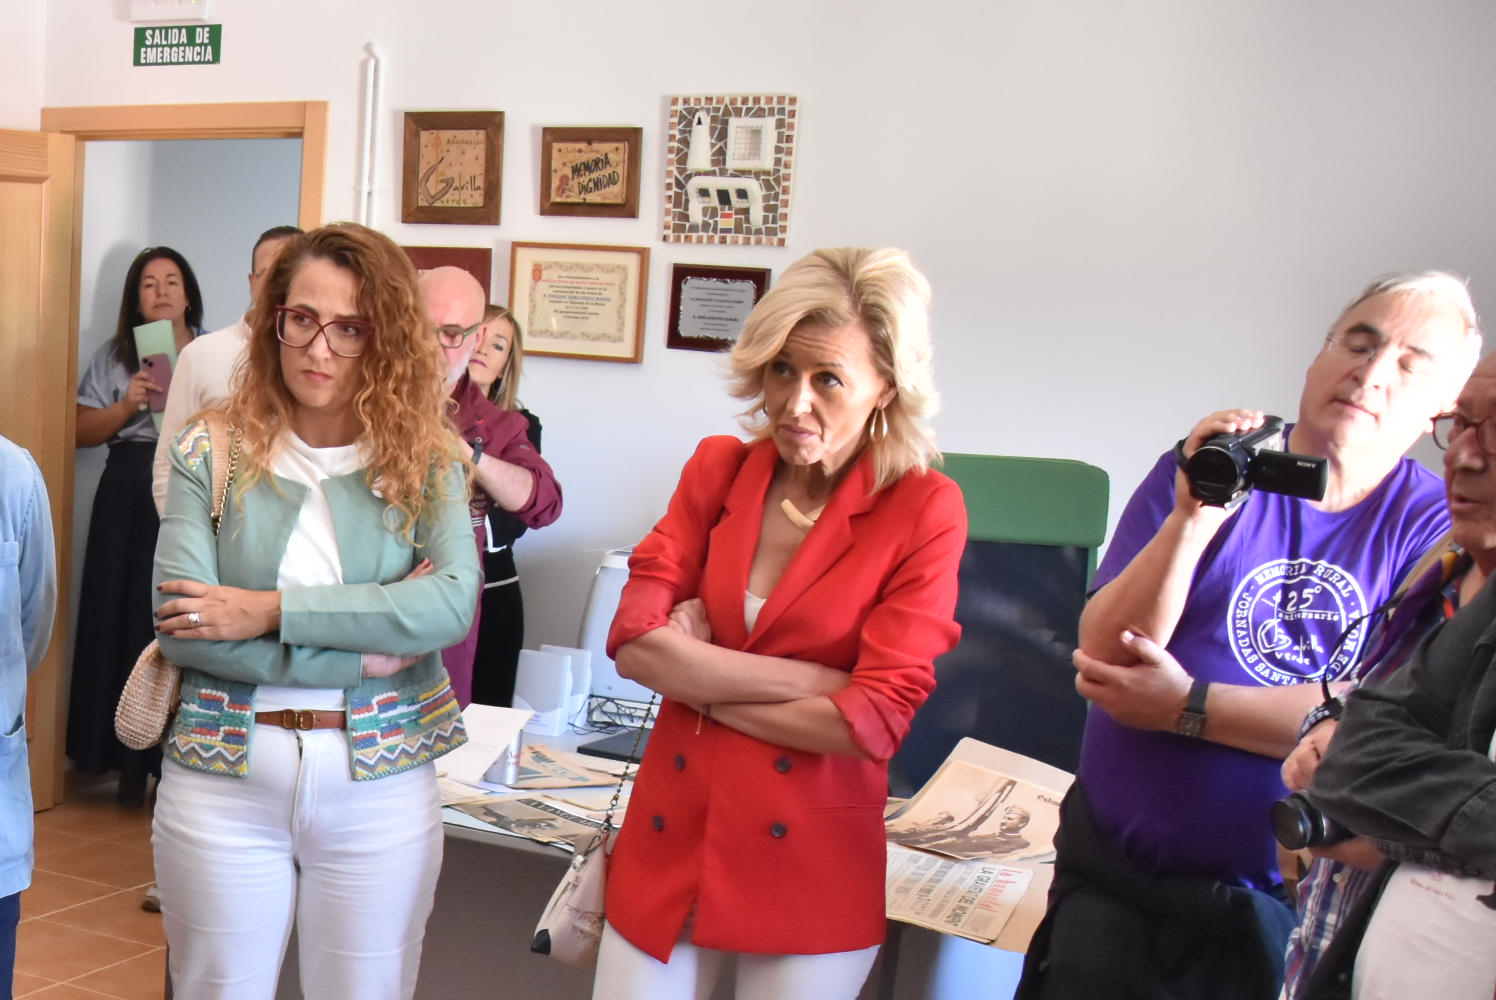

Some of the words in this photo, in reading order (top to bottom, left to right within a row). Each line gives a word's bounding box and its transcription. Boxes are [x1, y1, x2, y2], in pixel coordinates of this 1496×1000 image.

[145, 28, 188, 46] SALIDA
[195, 26, 210, 44] DE
[140, 45, 213, 64] EMERGENCIA
[1254, 564, 1306, 585] MEMORIA
[1313, 564, 1354, 598] RURAL
[1235, 592, 1259, 664] JORNADAS
[1254, 663, 1298, 686] SANTA
[1331, 654, 1349, 673] DE
